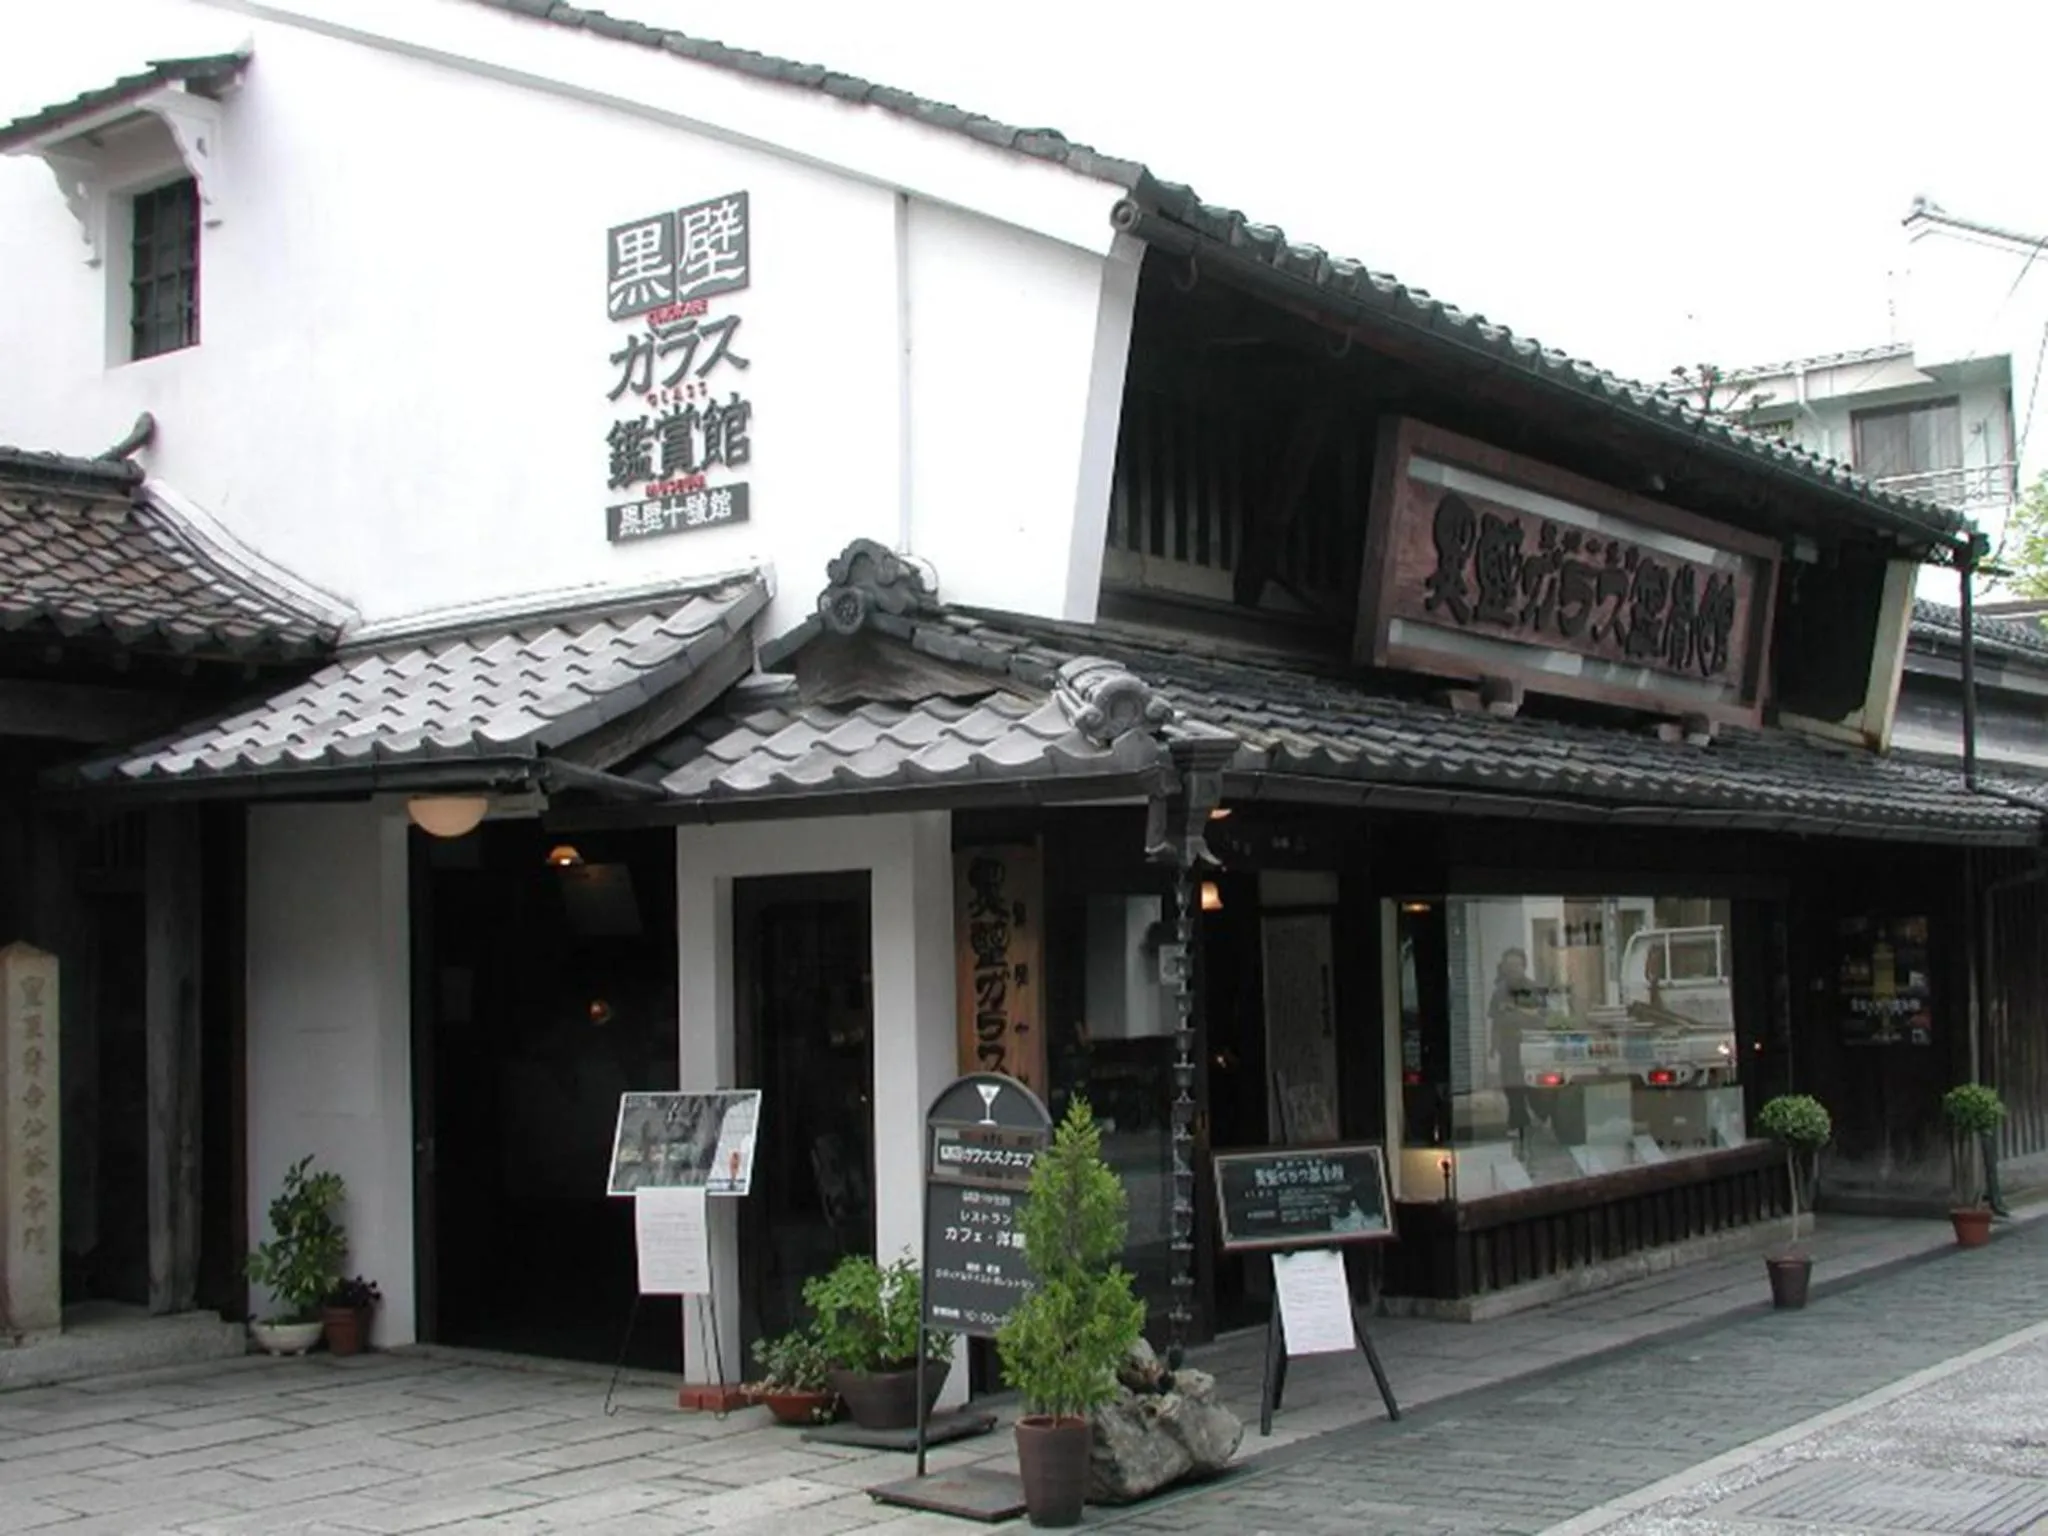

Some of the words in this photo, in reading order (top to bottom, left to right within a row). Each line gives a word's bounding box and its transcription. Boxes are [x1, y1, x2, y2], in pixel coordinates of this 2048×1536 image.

[608, 199, 746, 313] 黒壁
[606, 315, 750, 400] ガラス
[605, 392, 752, 490] 鑑賞館
[960, 1208, 1012, 1226] レストラン
